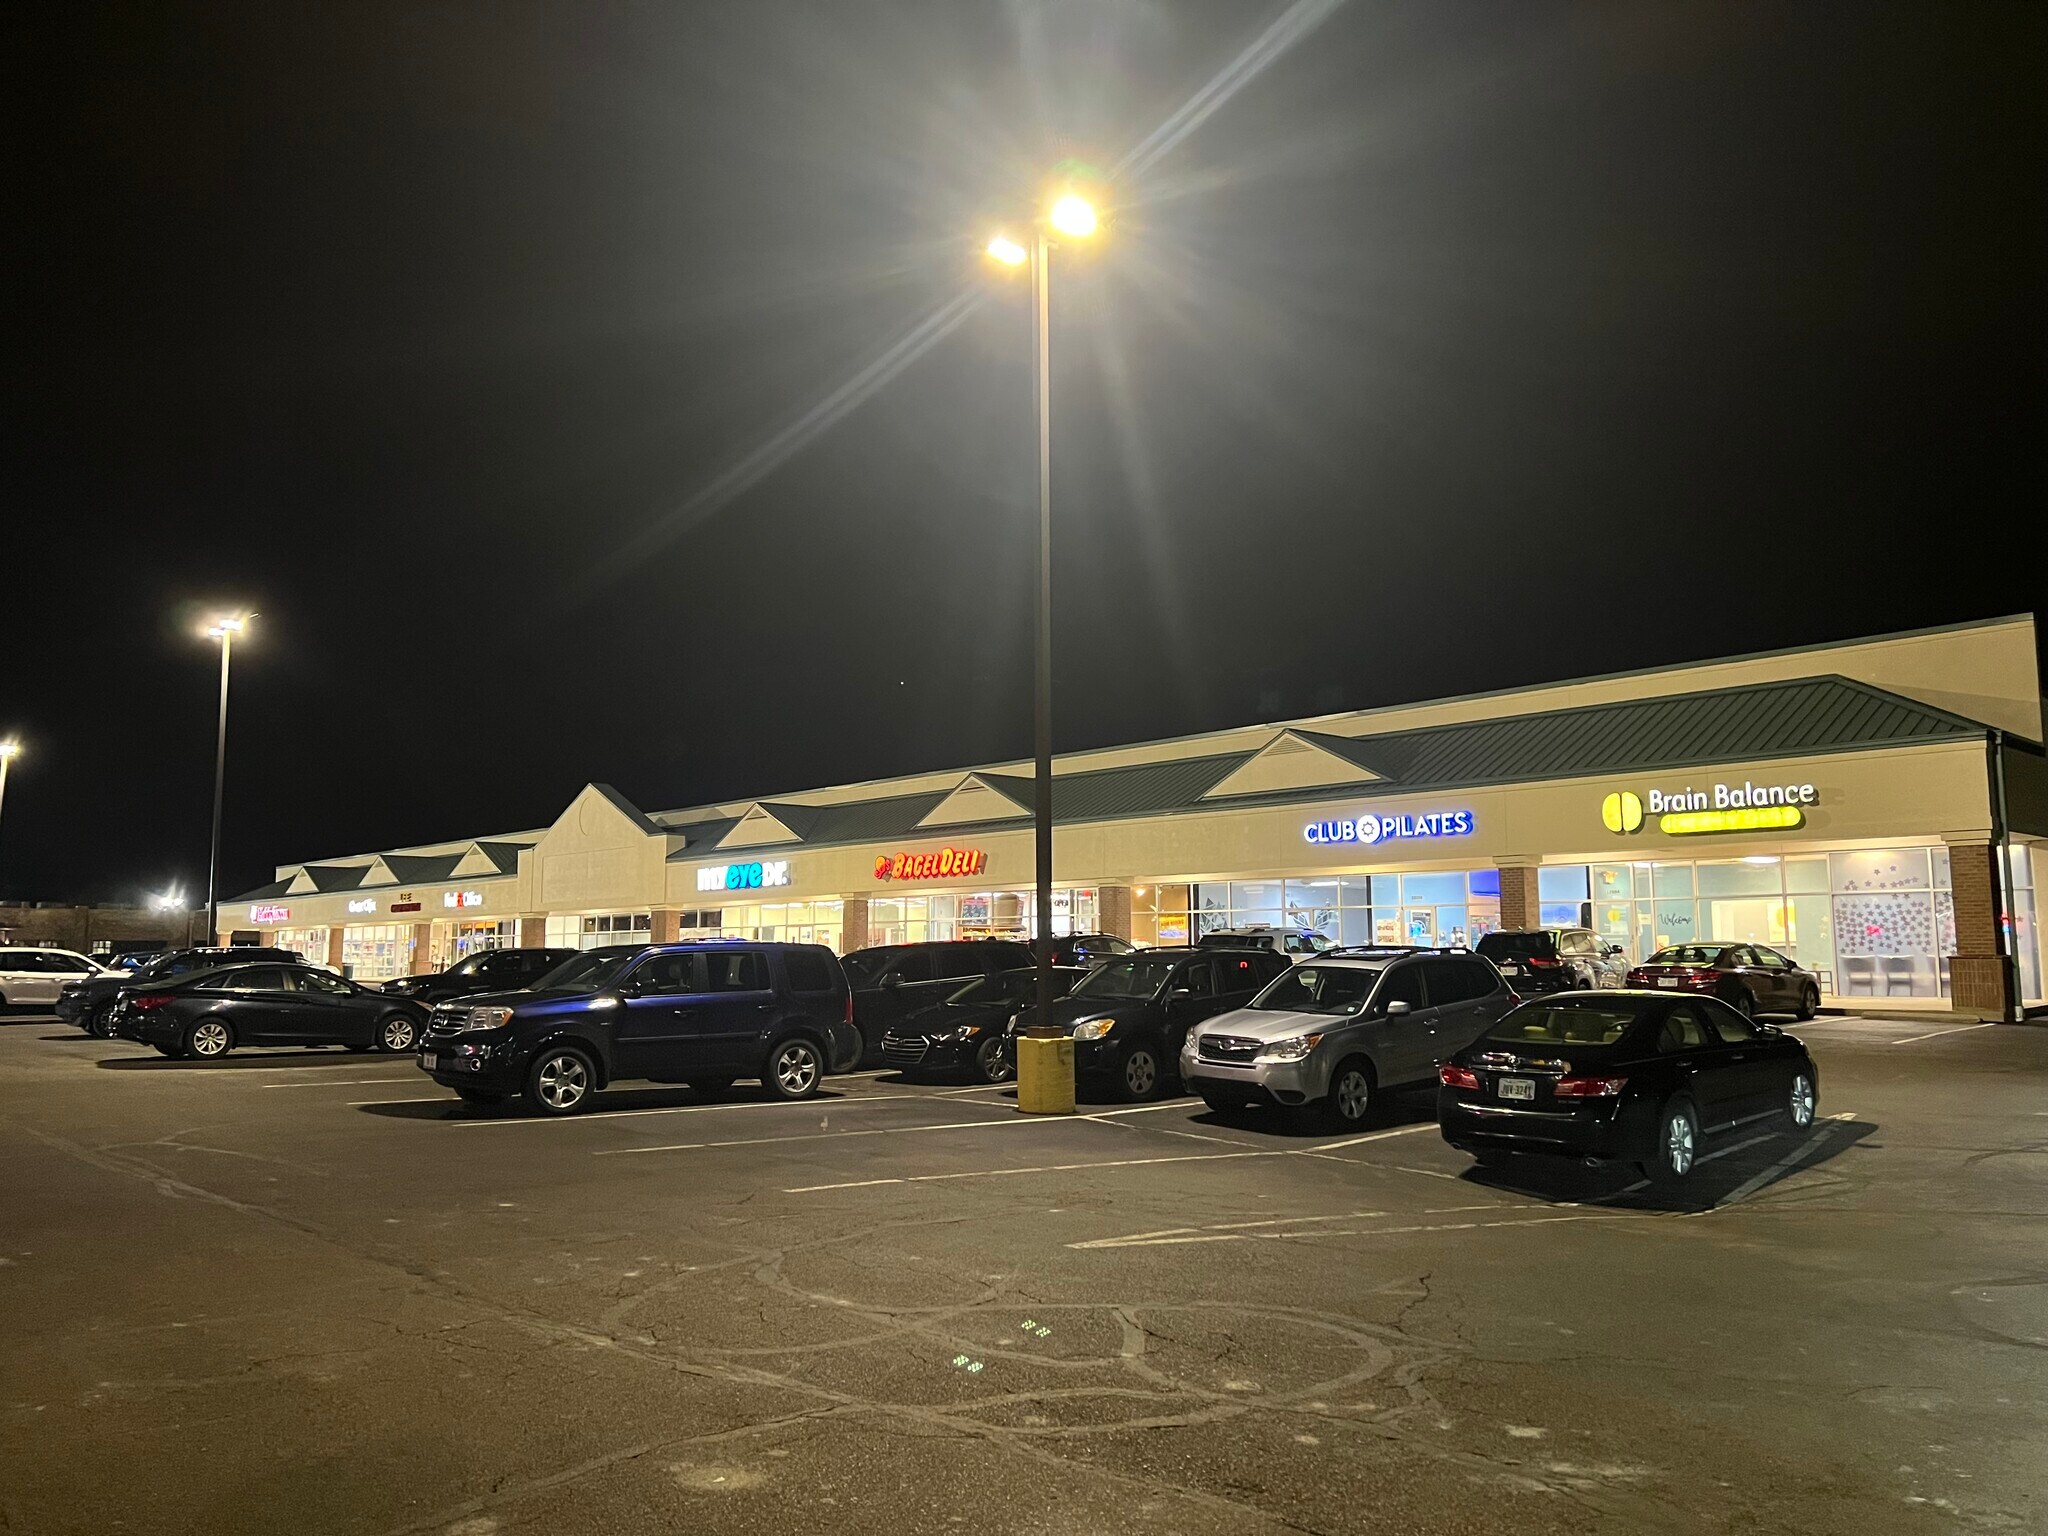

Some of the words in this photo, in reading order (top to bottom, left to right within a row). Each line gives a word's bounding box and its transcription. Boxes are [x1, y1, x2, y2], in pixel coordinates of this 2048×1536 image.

[1648, 786, 1708, 813] Brain
[1714, 780, 1815, 809] Balance
[1303, 820, 1356, 844] CLUB
[1381, 811, 1471, 838] PILATES
